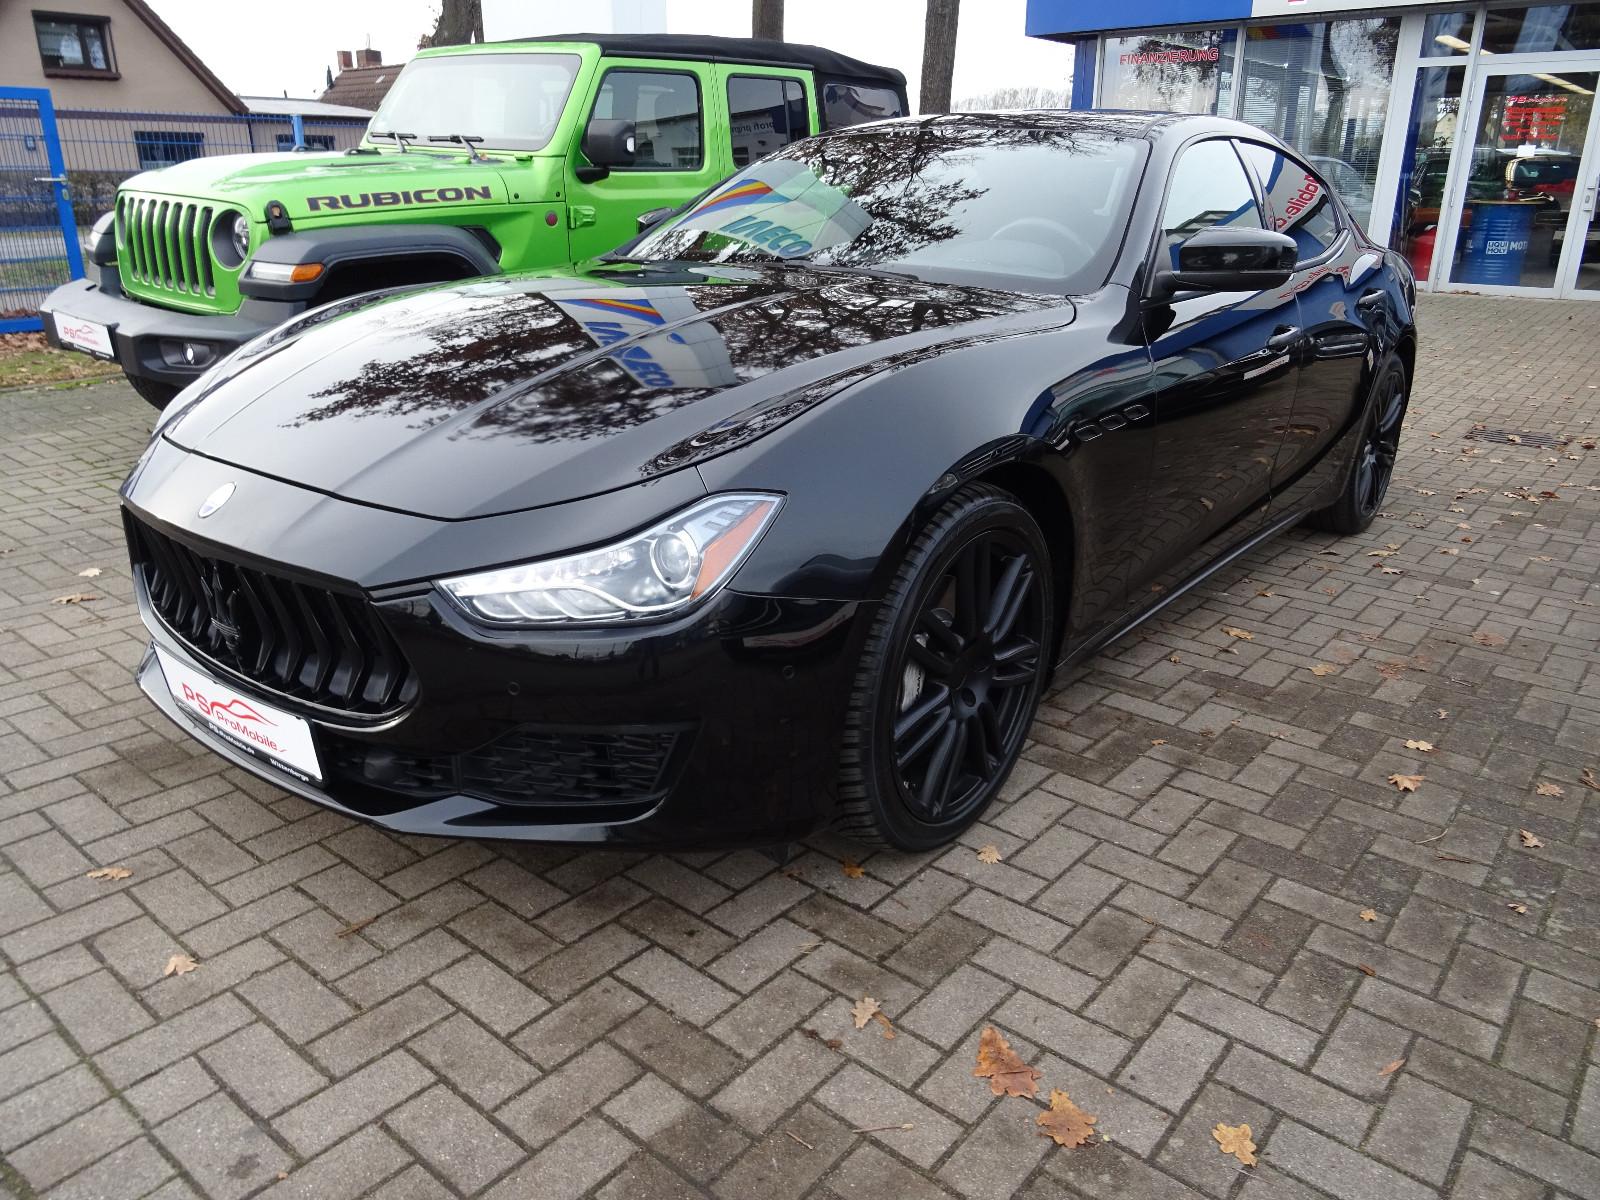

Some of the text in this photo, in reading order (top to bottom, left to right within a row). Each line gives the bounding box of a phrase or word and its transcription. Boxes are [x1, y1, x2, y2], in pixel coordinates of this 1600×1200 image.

[1120, 48, 1219, 65] FINANZIERUNG
[306, 186, 492, 212] RUBICON
[182, 682, 211, 716] PS
[215, 710, 278, 751] ProMobile
